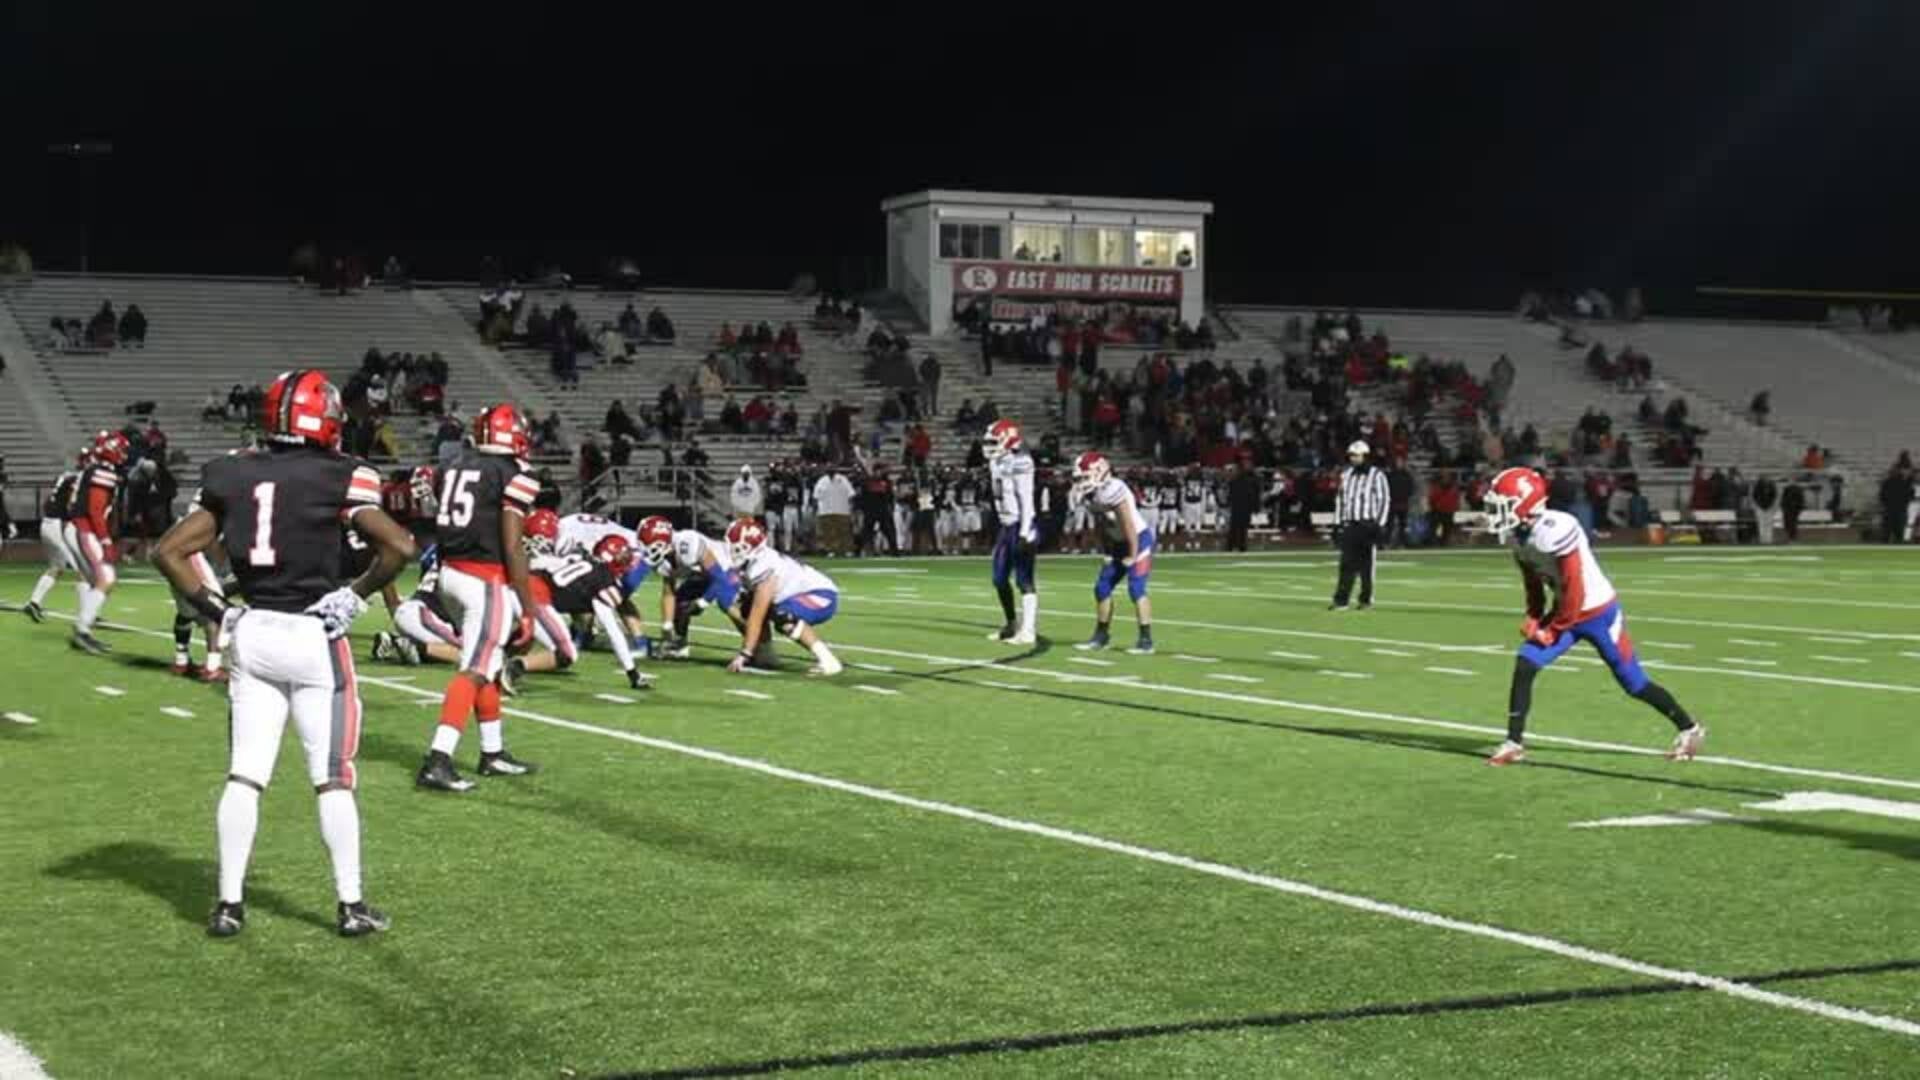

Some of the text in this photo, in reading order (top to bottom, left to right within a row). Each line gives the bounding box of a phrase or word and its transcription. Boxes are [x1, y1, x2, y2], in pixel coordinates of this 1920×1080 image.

[1007, 270, 1047, 289] EAST
[1053, 272, 1094, 291] HIGH
[1099, 274, 1175, 294] SCARLETS
[248, 482, 276, 566] 1
[436, 469, 481, 528] 15
